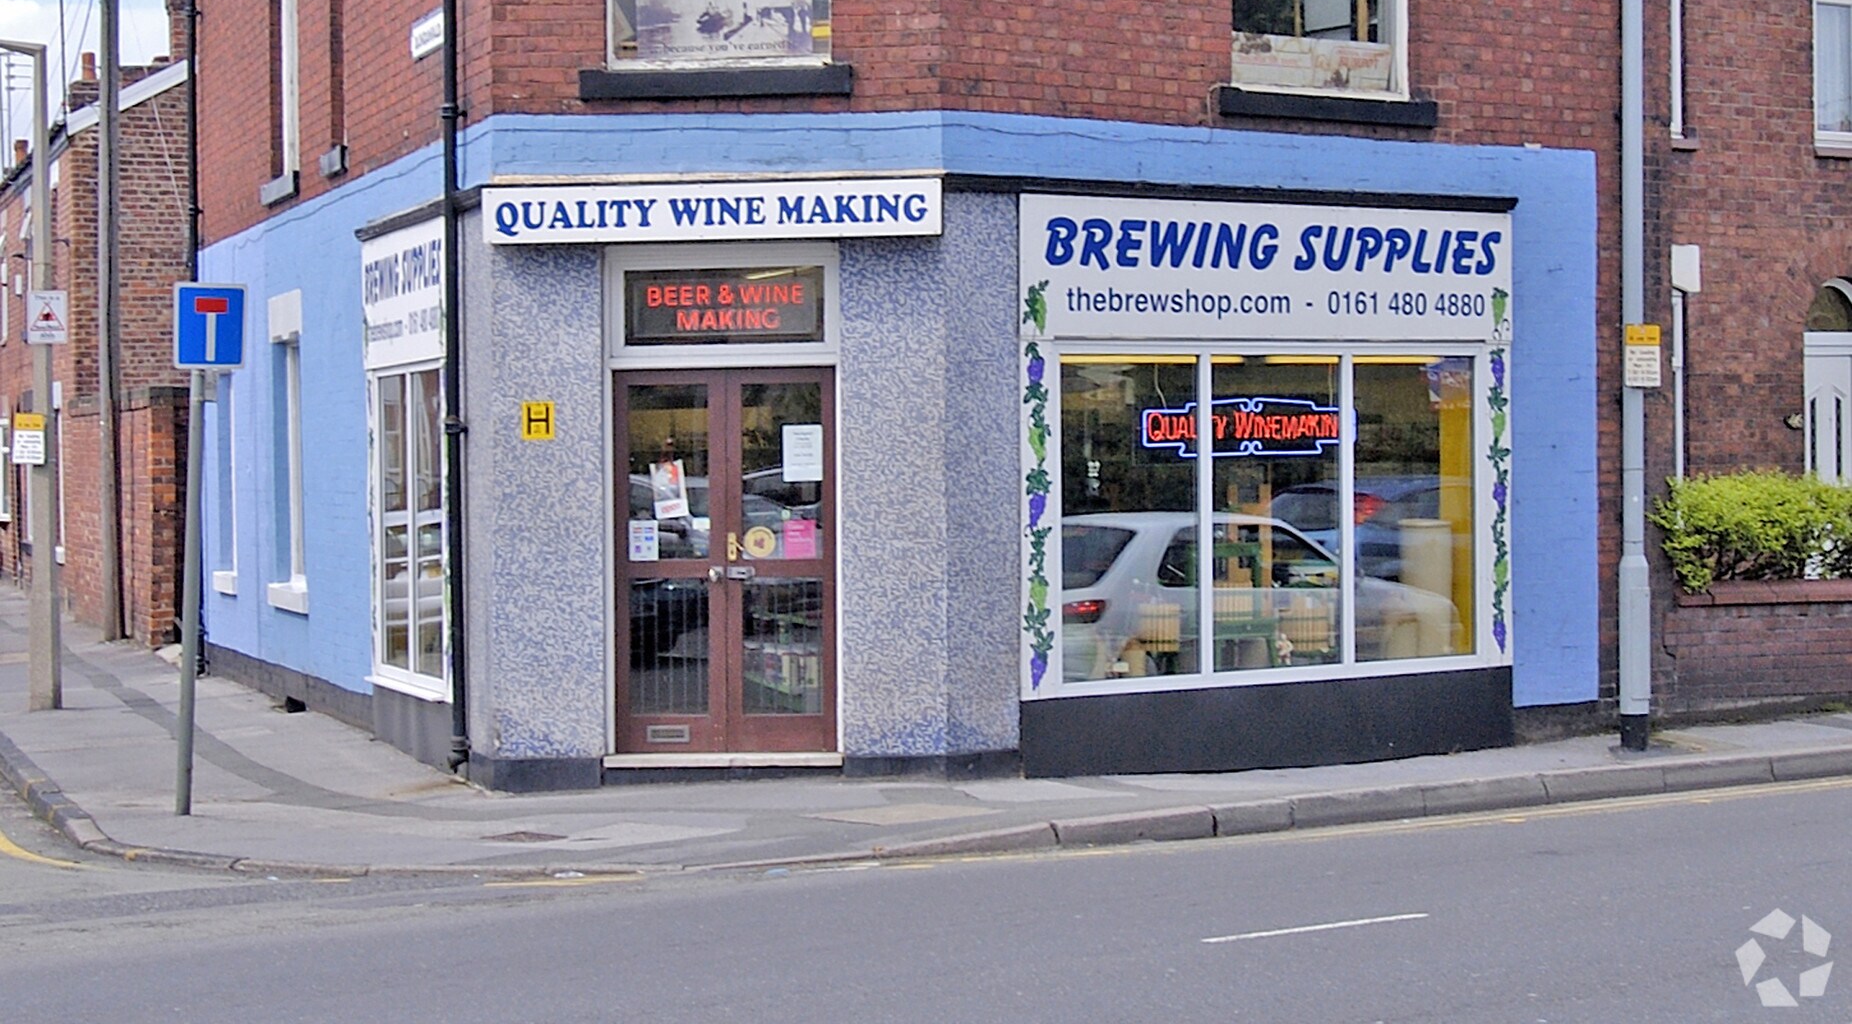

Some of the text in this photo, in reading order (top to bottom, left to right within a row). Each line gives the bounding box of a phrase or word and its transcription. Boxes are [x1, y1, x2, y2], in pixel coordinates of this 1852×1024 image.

[495, 194, 929, 237] QUALITY WINE MAKING
[1044, 216, 1502, 276] BREWING SUPPLIES
[401, 238, 442, 295] SUPPLIES
[647, 283, 804, 308] BEER & WINE
[1066, 286, 1291, 321] thebrewshop.com
[1327, 290, 1378, 315] 0161
[1388, 291, 1427, 316] 480
[1434, 292, 1485, 317] 4880
[676, 307, 781, 331] MAKING
[527, 406, 550, 435] H
[1147, 409, 1338, 441] QUALY WINEMAKIN
